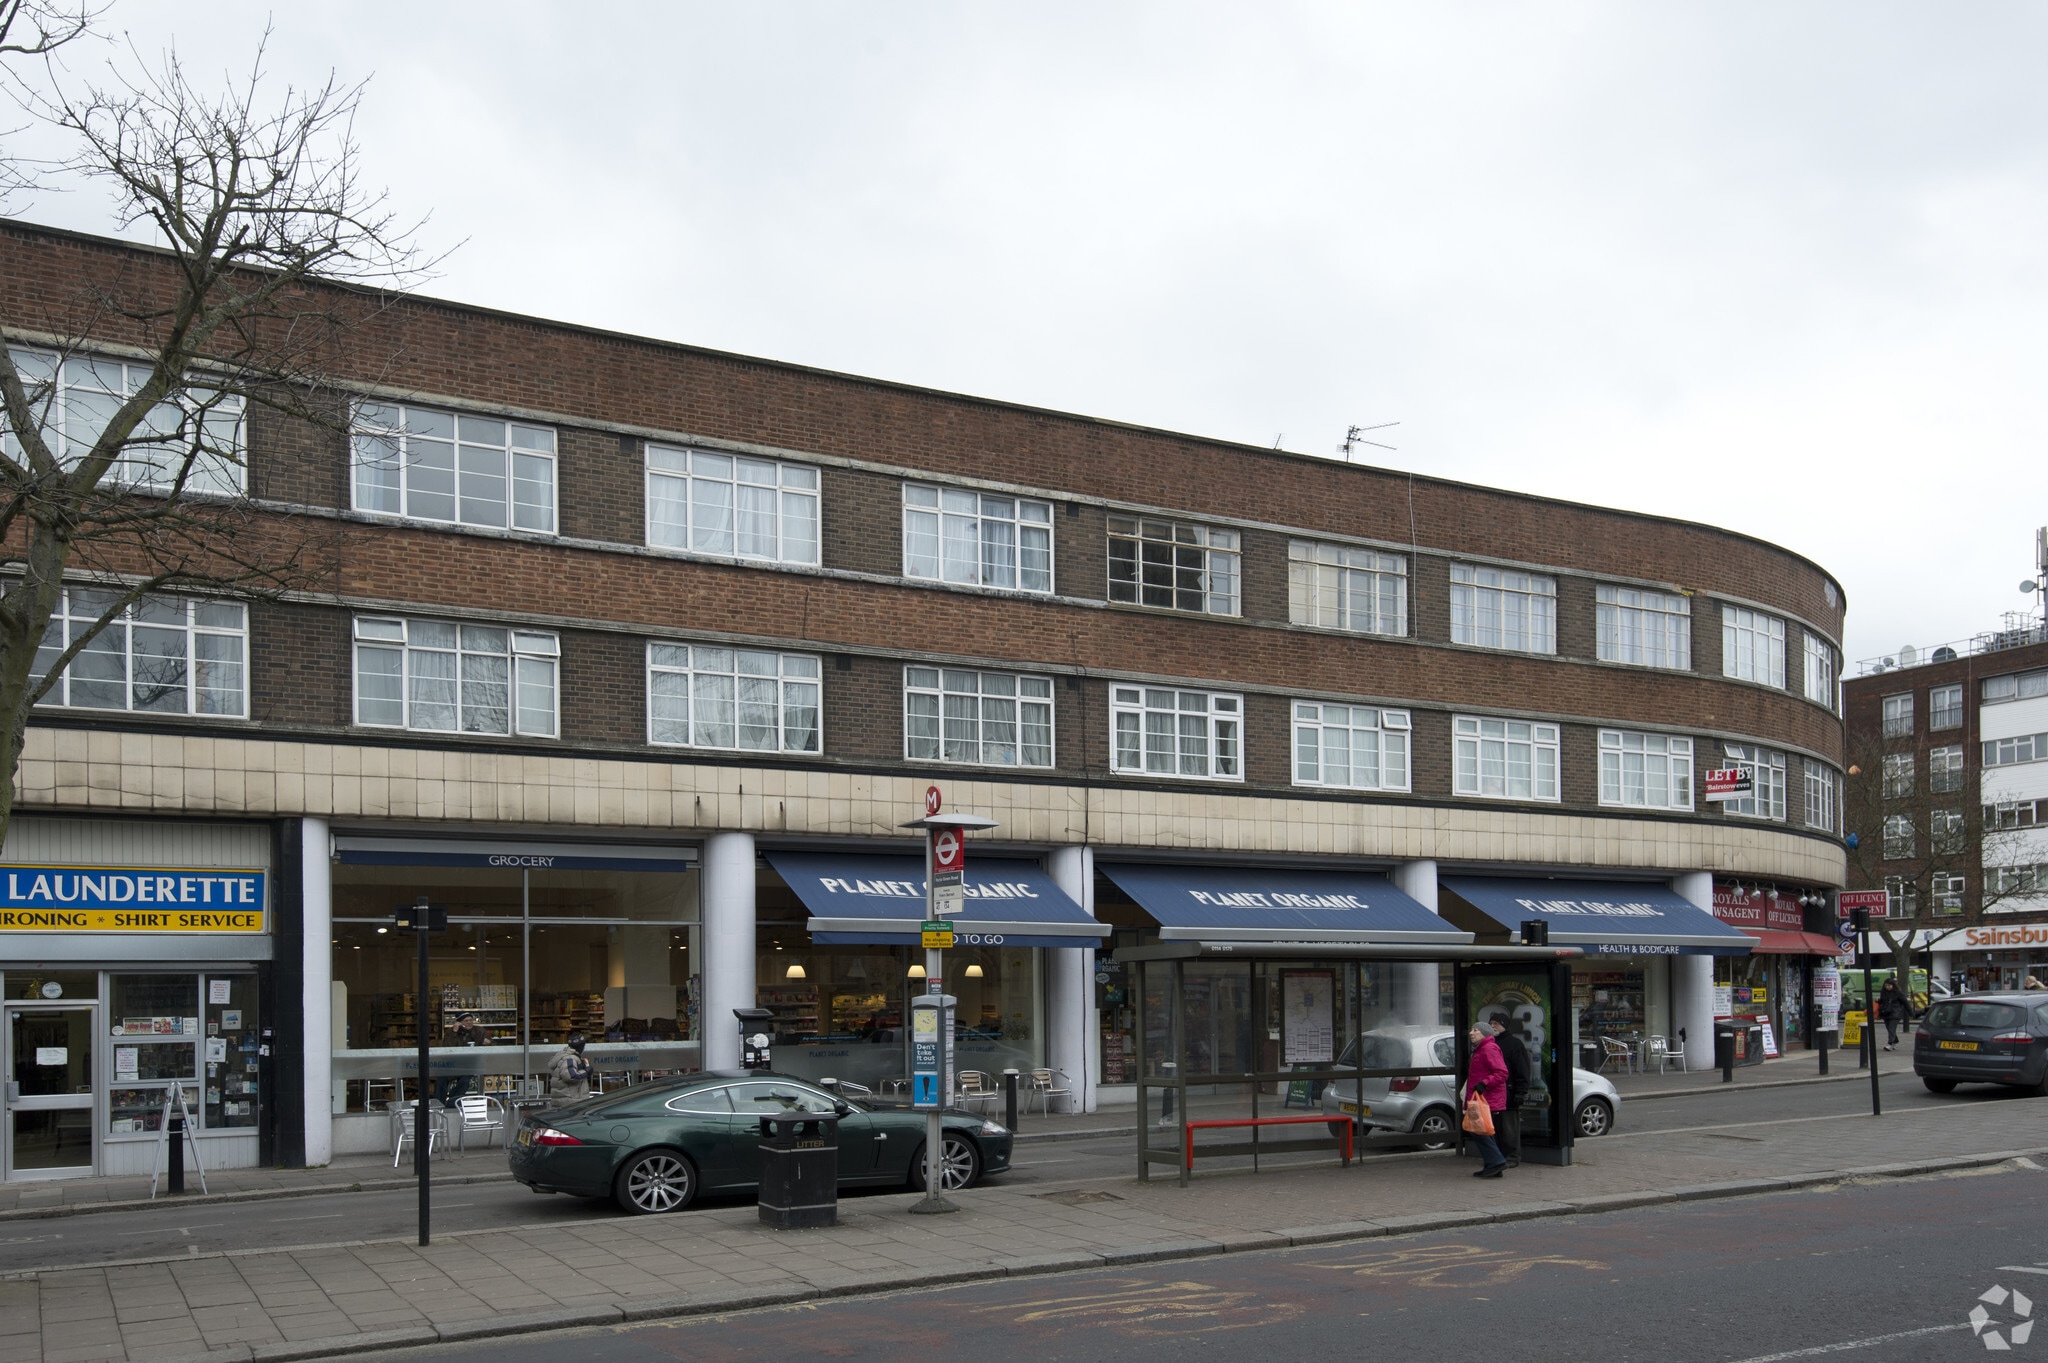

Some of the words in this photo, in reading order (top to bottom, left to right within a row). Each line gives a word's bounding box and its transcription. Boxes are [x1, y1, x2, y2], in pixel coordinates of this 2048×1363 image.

[1706, 768, 1734, 781] LET
[1736, 767, 1752, 780] BY
[926, 791, 937, 810] M
[488, 855, 554, 867] GROCERY
[8, 873, 255, 903] LAUNDERETTE
[819, 877, 921, 897] PLANET
[922, 880, 1040, 899] GANIC
[1189, 890, 1273, 907] PLANET
[1271, 893, 1370, 909] ORGANIC
[1713, 893, 1750, 906] ROYALS
[1841, 895, 1855, 904] OFF
[1855, 893, 1885, 903] LICENCE
[1515, 898, 1588, 914] PLANET
[1582, 901, 1665, 916] ORGANIC
[1713, 906, 1760, 920] WSAGENT
[1775, 900, 1796, 912] ROYALS
[114, 913, 171, 927] SHIRT
[179, 914, 255, 927] SERVICE
[1768, 911, 1779, 922] OFF
[1779, 912, 1802, 925] LICENCE
[963, 934, 981, 944] TO
[984, 934, 1004, 945] GO
[1599, 944, 1630, 953] HEALTH
[1632, 945, 1637, 953] &
[1640, 945, 1680, 955] BODYCARE
[1519, 984, 1542, 1005] LUNCH
[593, 1056, 614, 1064] PLANET
[615, 1055, 640, 1063] ORGANIC
[797, 1139, 824, 1148] LITTER
